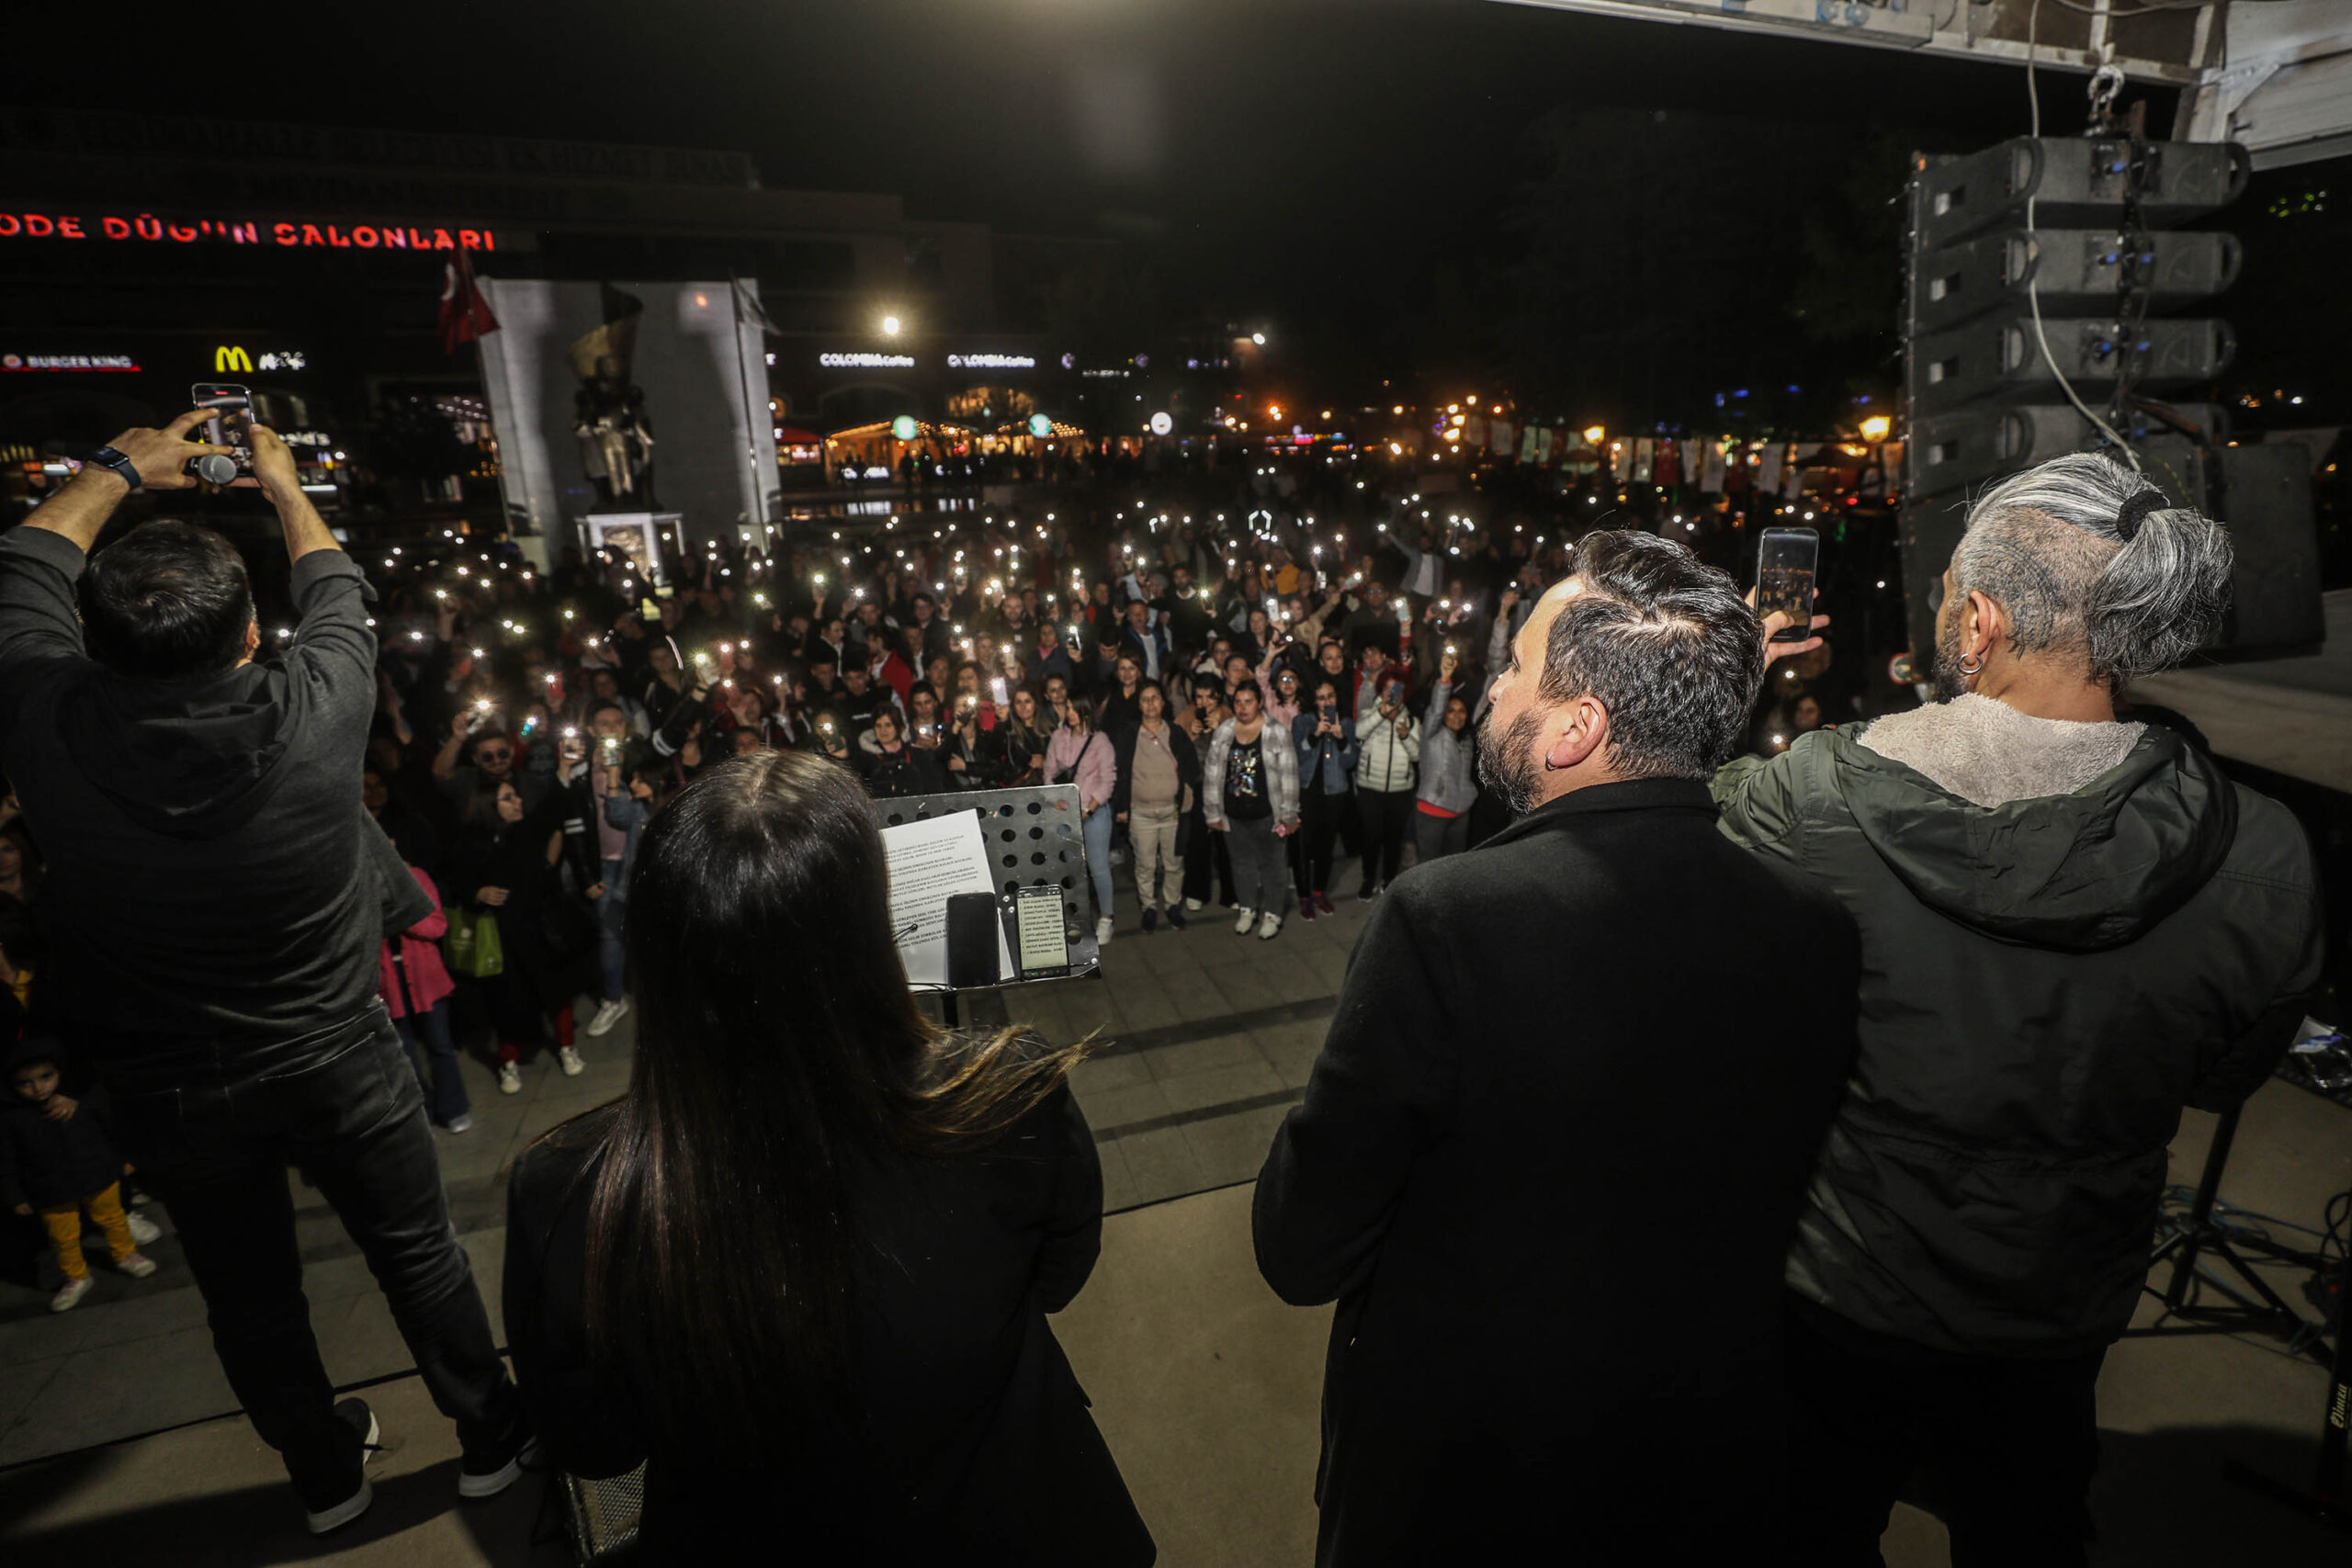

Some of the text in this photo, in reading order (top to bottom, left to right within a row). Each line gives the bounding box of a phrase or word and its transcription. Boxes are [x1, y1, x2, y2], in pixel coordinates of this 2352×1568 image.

[274, 223, 494, 252] SALONLARI
[27, 355, 132, 368] BURGER KING
